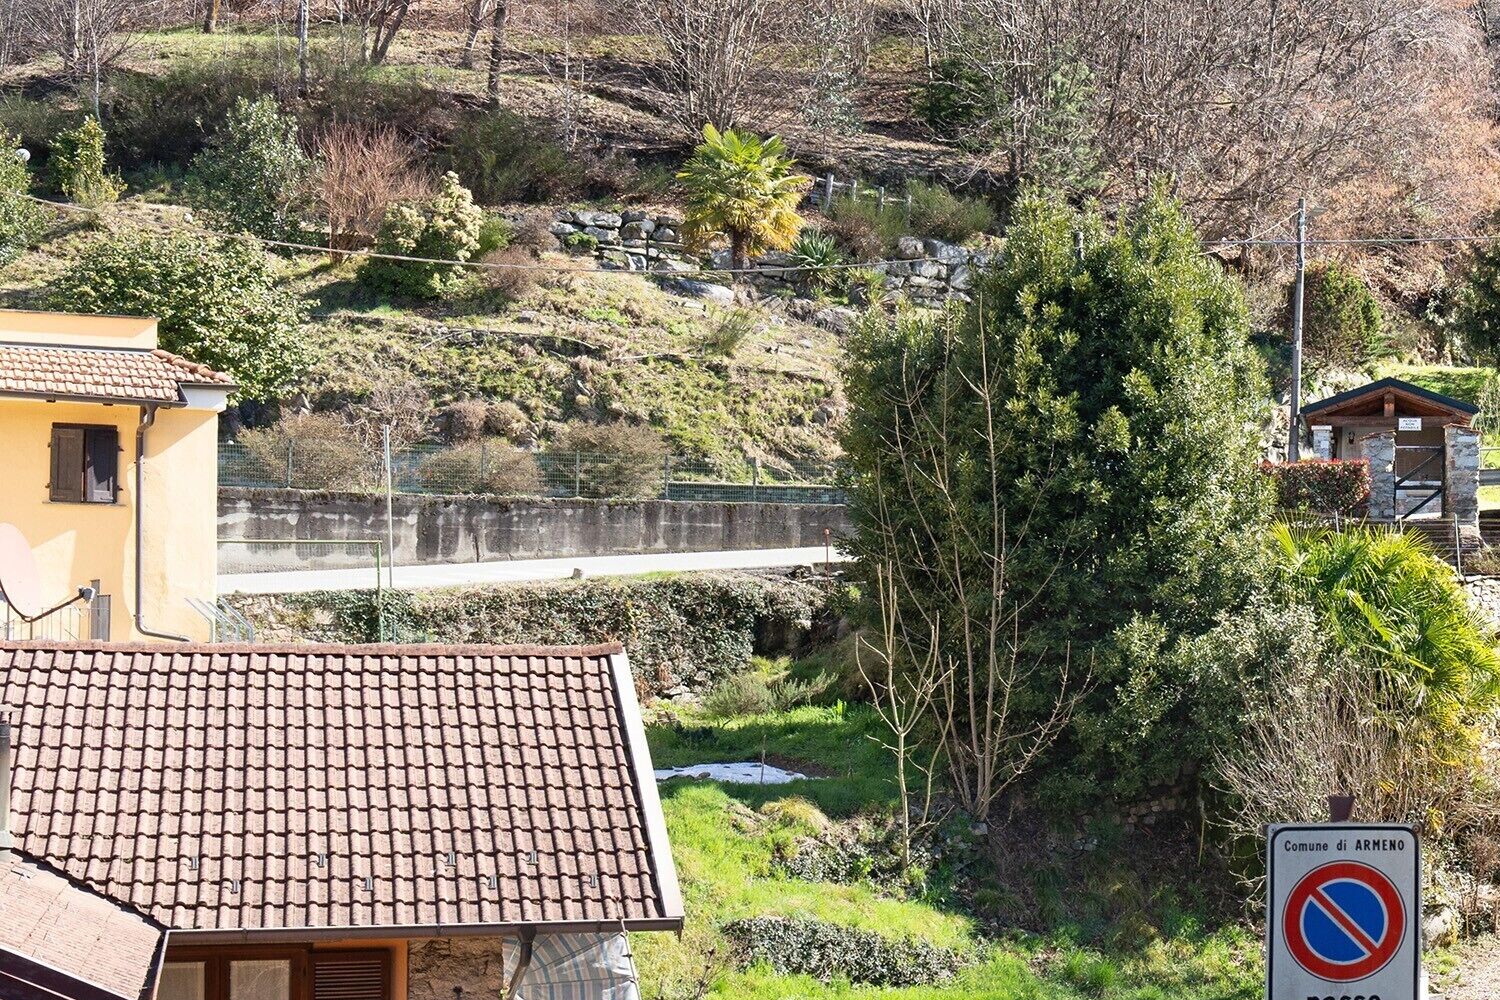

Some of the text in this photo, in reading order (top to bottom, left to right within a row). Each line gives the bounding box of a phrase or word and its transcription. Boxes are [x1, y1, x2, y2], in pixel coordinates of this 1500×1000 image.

[1284, 839, 1405, 851] Comune di ARMENO
